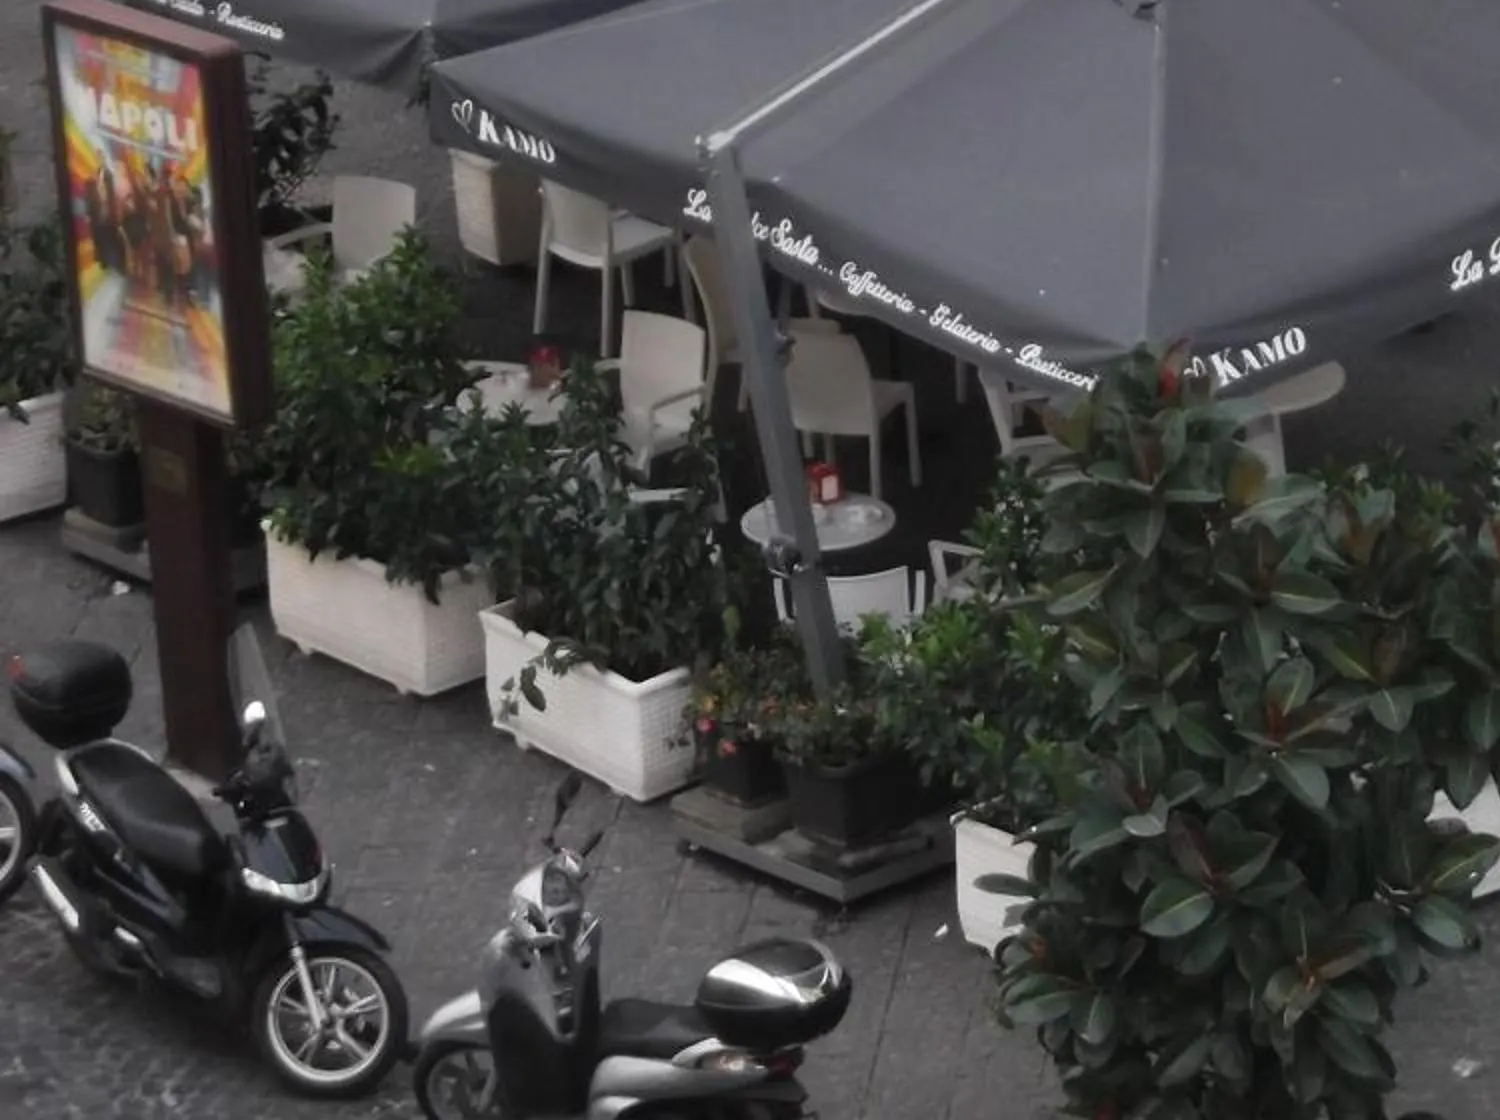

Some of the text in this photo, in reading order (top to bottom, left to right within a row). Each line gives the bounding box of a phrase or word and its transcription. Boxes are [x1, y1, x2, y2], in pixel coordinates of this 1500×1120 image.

[478, 109, 556, 163] KAMO
[682, 189, 712, 223] La
[840, 261, 914, 315] Caffetteria
[929, 303, 1000, 354] Gelateria
[1014, 343, 1099, 392] Pasticceri
[1450, 248, 1484, 292] La
[1210, 326, 1307, 388] KAMO
